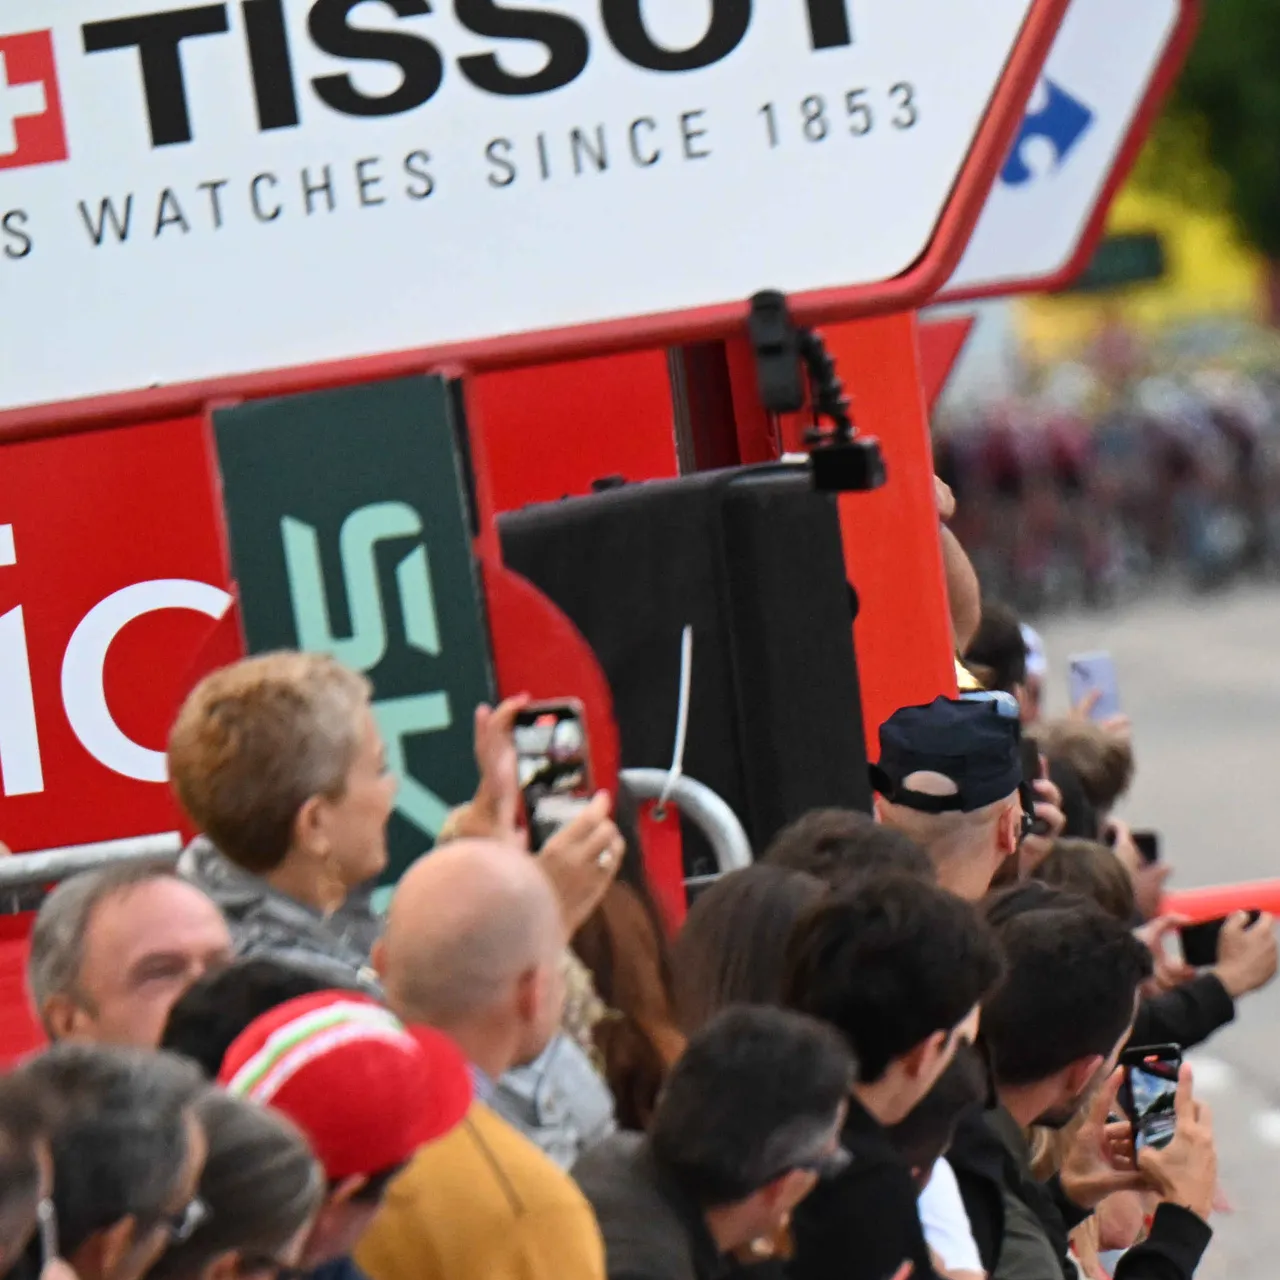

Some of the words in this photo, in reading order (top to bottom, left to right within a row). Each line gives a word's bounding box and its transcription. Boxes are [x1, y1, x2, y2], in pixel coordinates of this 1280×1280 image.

[79, 149, 436, 247] WATCHES
[483, 109, 712, 189] SINCE
[757, 81, 920, 149] 1853
